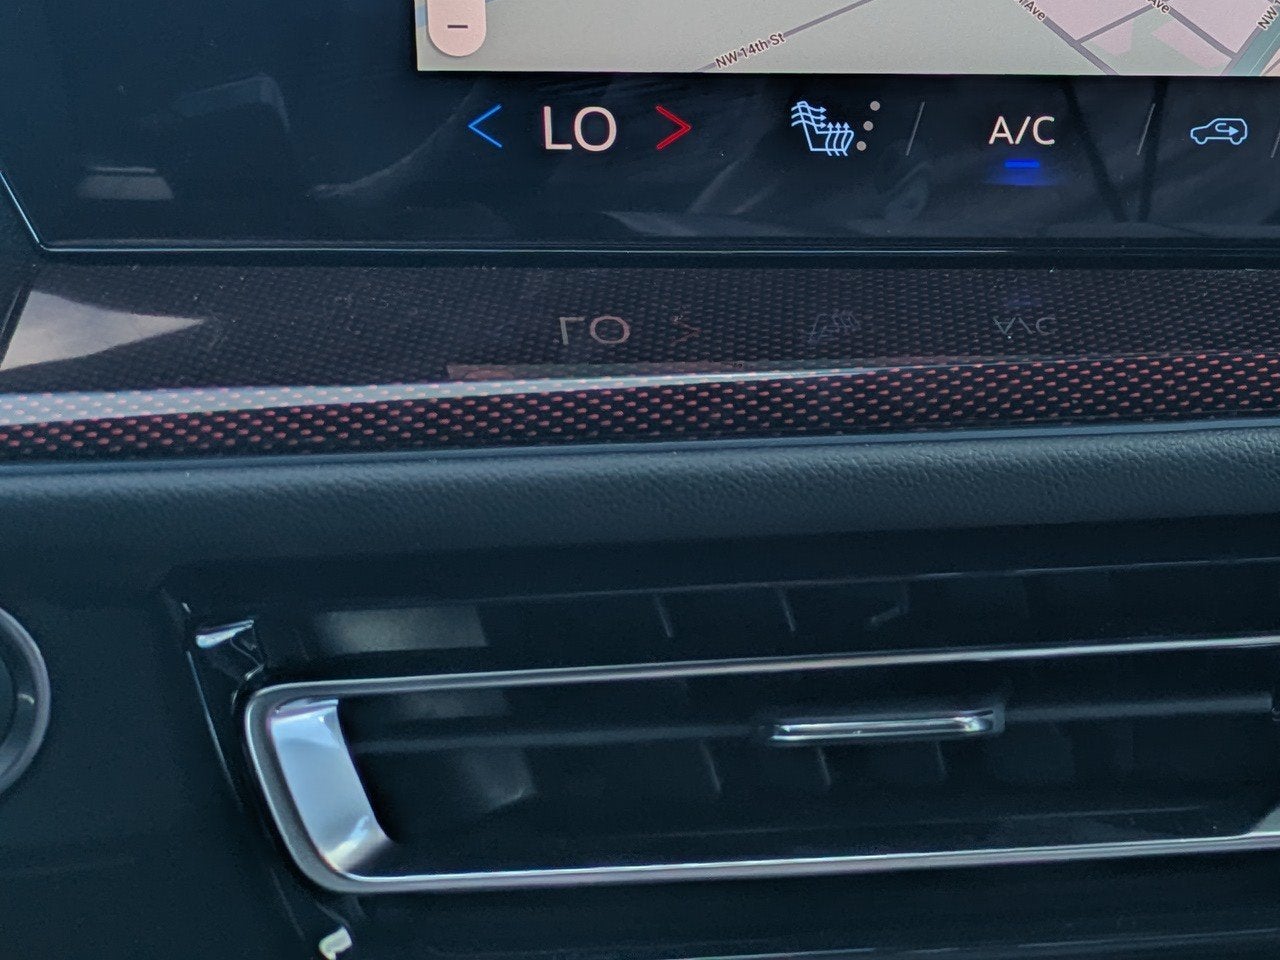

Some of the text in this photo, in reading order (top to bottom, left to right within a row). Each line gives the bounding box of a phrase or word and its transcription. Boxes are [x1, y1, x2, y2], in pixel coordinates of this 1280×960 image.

[1024, 0, 1046, 21] Ave
[1257, 7, 1277, 29] NW
[715, 32, 786, 69] NW 14th St
[543, 106, 617, 151] LO
[988, 116, 1056, 146] A/C
